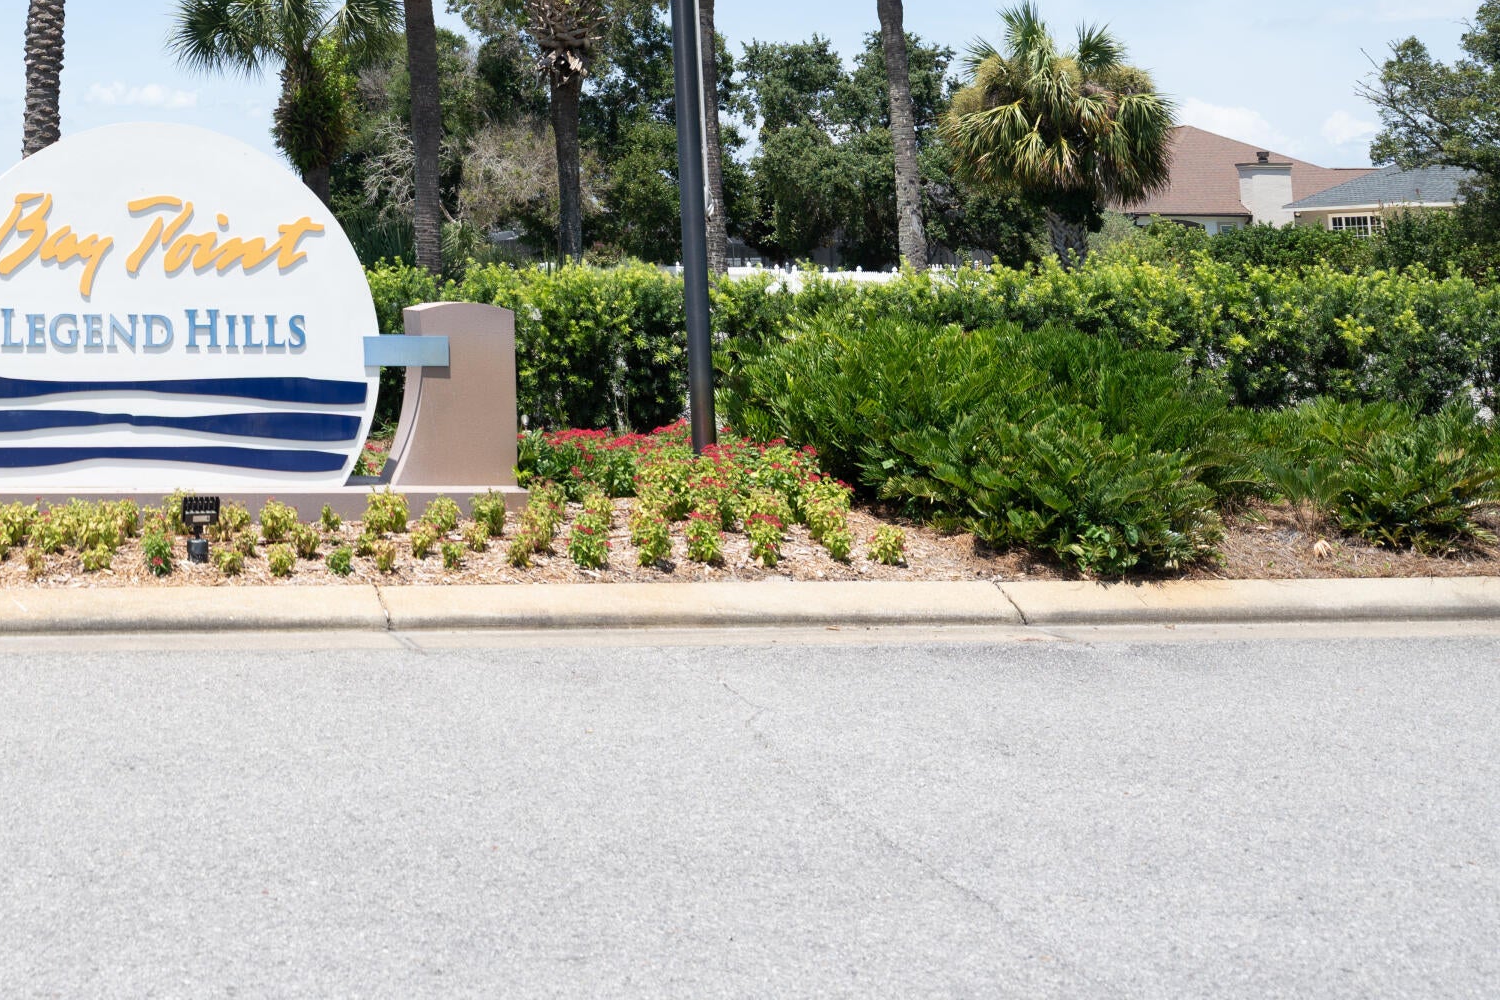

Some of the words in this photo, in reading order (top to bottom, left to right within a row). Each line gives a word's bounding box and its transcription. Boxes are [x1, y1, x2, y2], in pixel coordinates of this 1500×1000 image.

[126, 196, 325, 273] Point
[0, 308, 174, 350] LEGEND
[185, 308, 307, 350] HILLS
